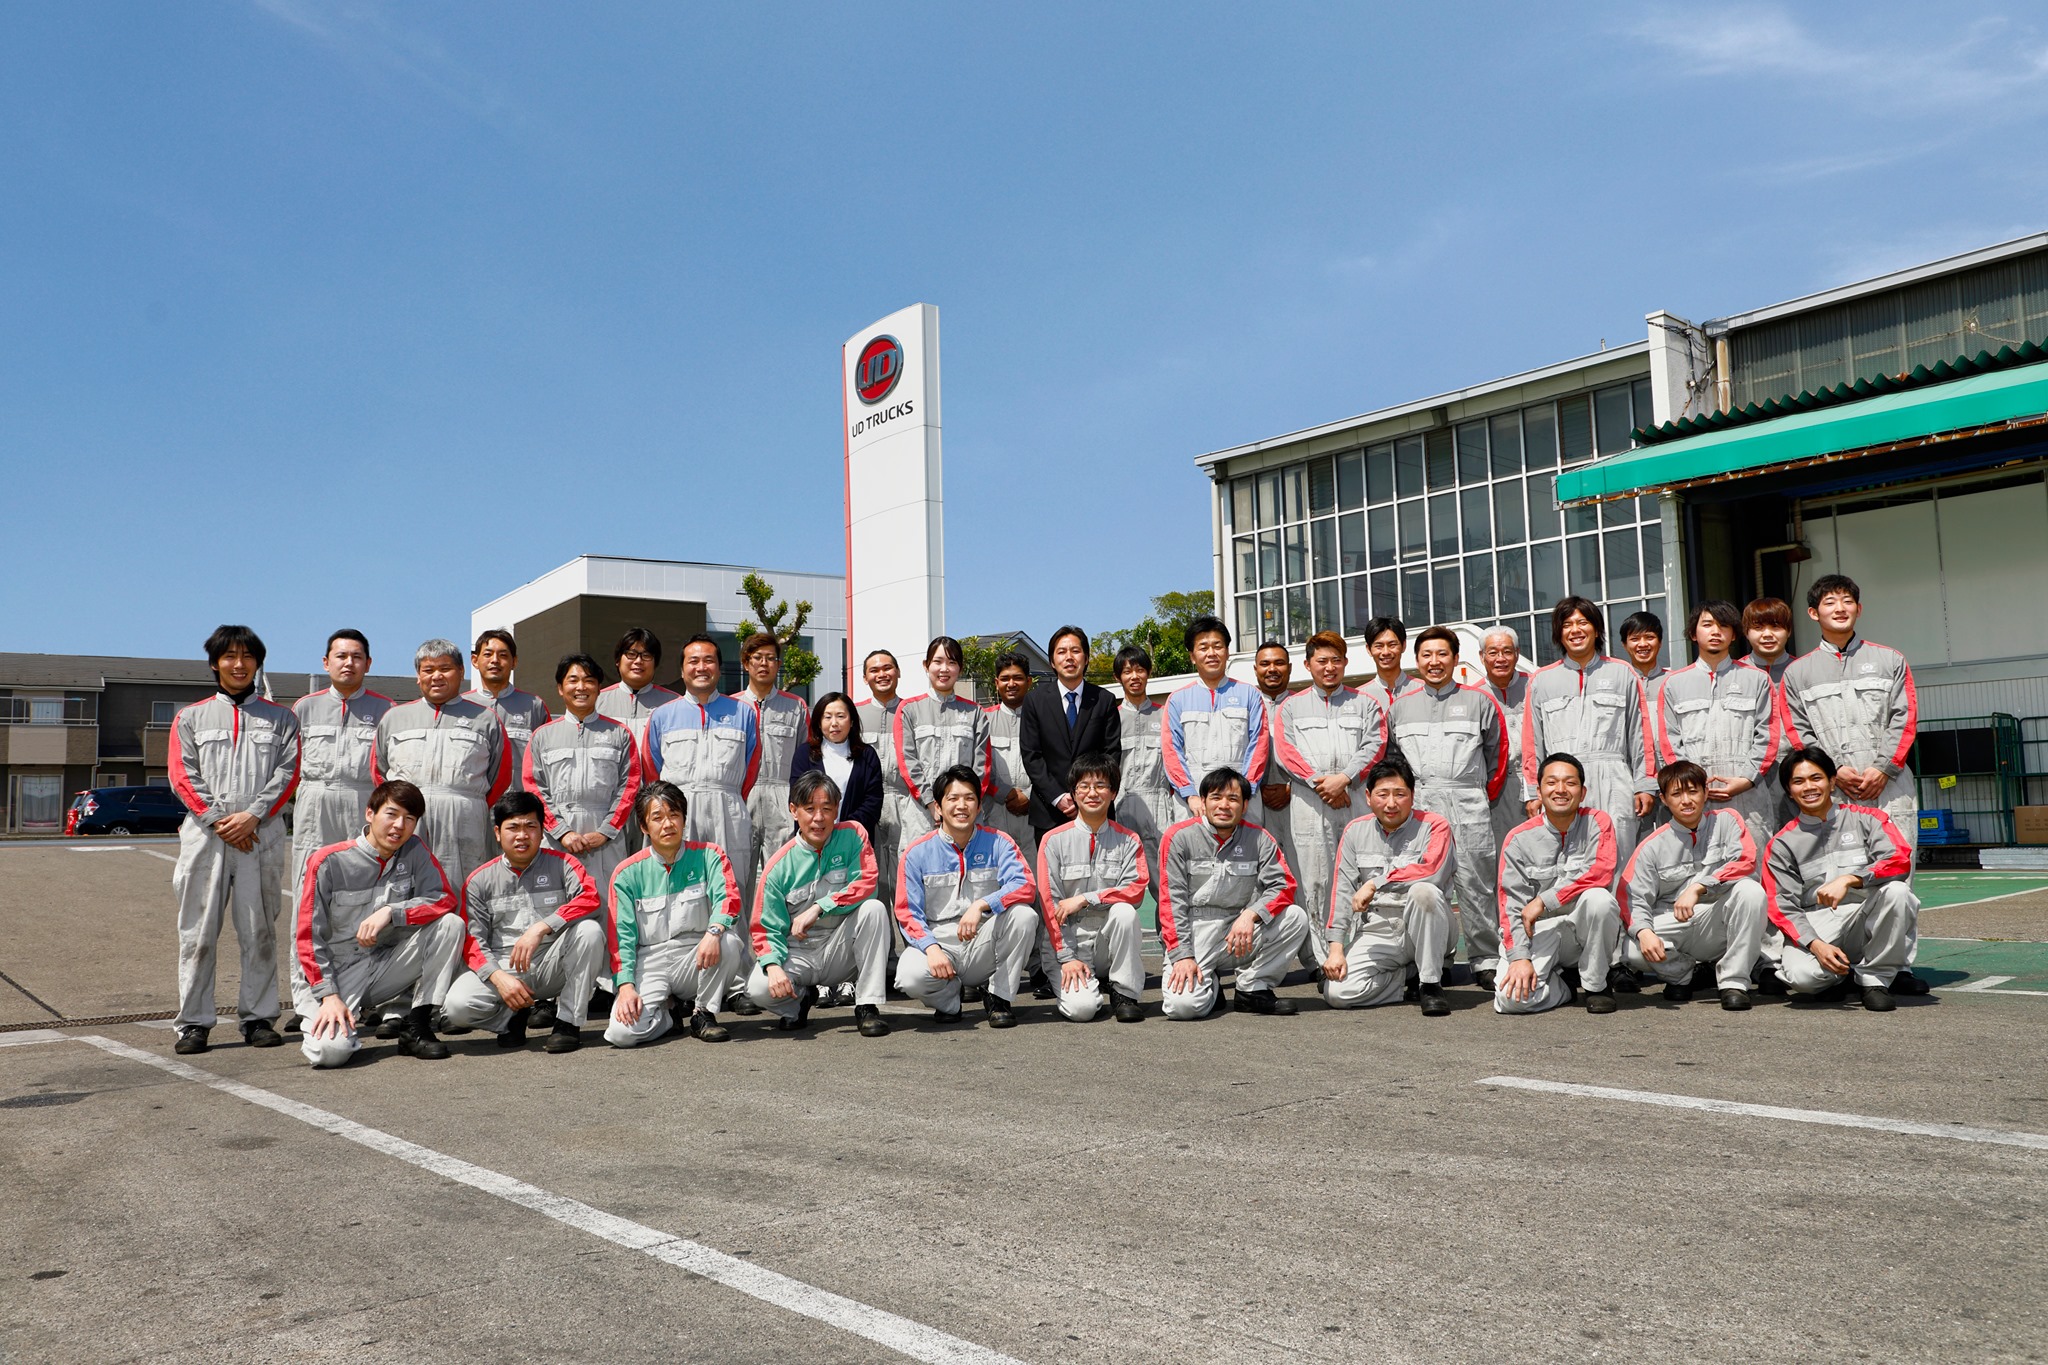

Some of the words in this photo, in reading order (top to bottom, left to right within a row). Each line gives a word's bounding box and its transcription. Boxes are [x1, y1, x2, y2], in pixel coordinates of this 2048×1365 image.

[857, 348, 897, 389] UD
[852, 421, 864, 438] UD
[866, 400, 914, 429] TRUCKS
